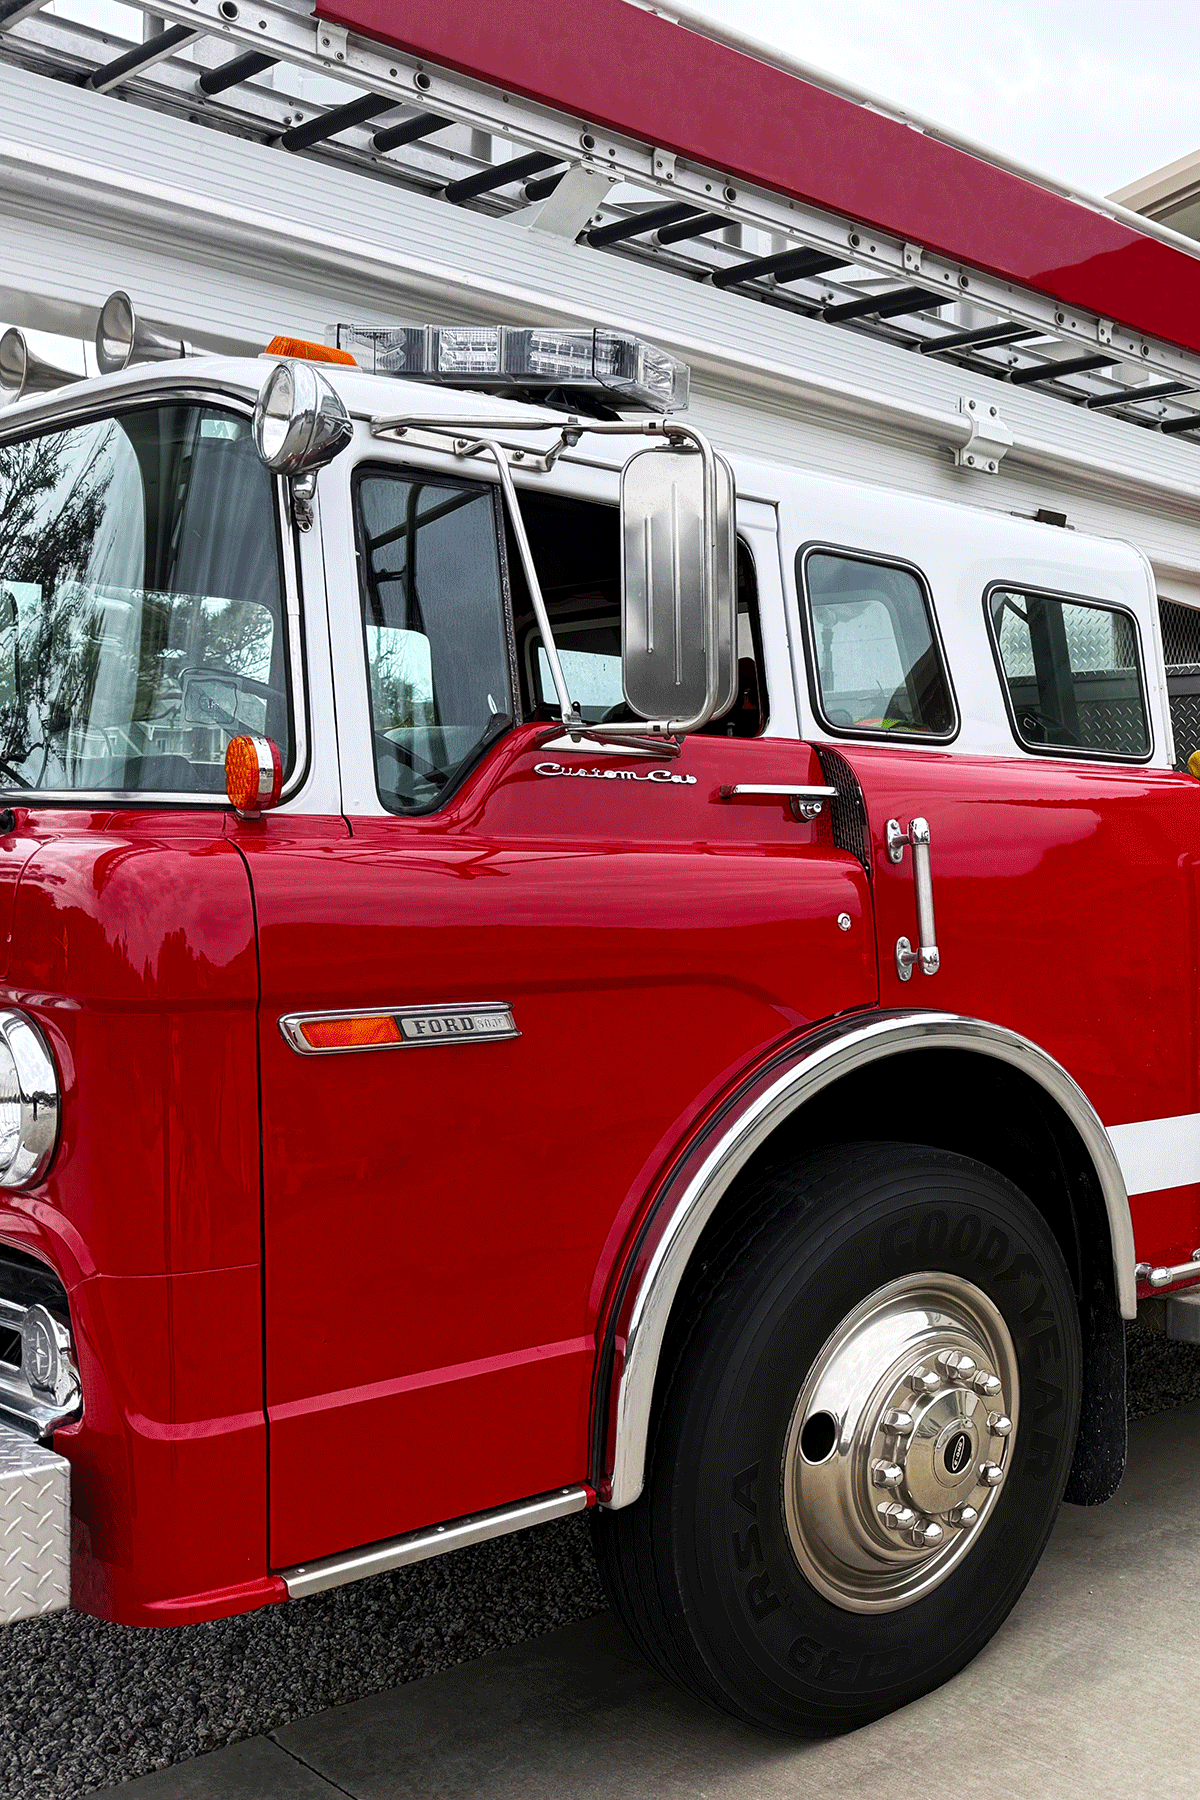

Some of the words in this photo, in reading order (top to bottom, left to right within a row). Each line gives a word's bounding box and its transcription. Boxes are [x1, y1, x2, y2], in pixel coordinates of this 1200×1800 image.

[533, 762, 649, 781] Custom
[649, 769, 698, 785] Cab
[413, 1017, 475, 1034] FORD
[878, 1209, 1063, 1482] GOODYEAR
[733, 1460, 784, 1625] RSA
